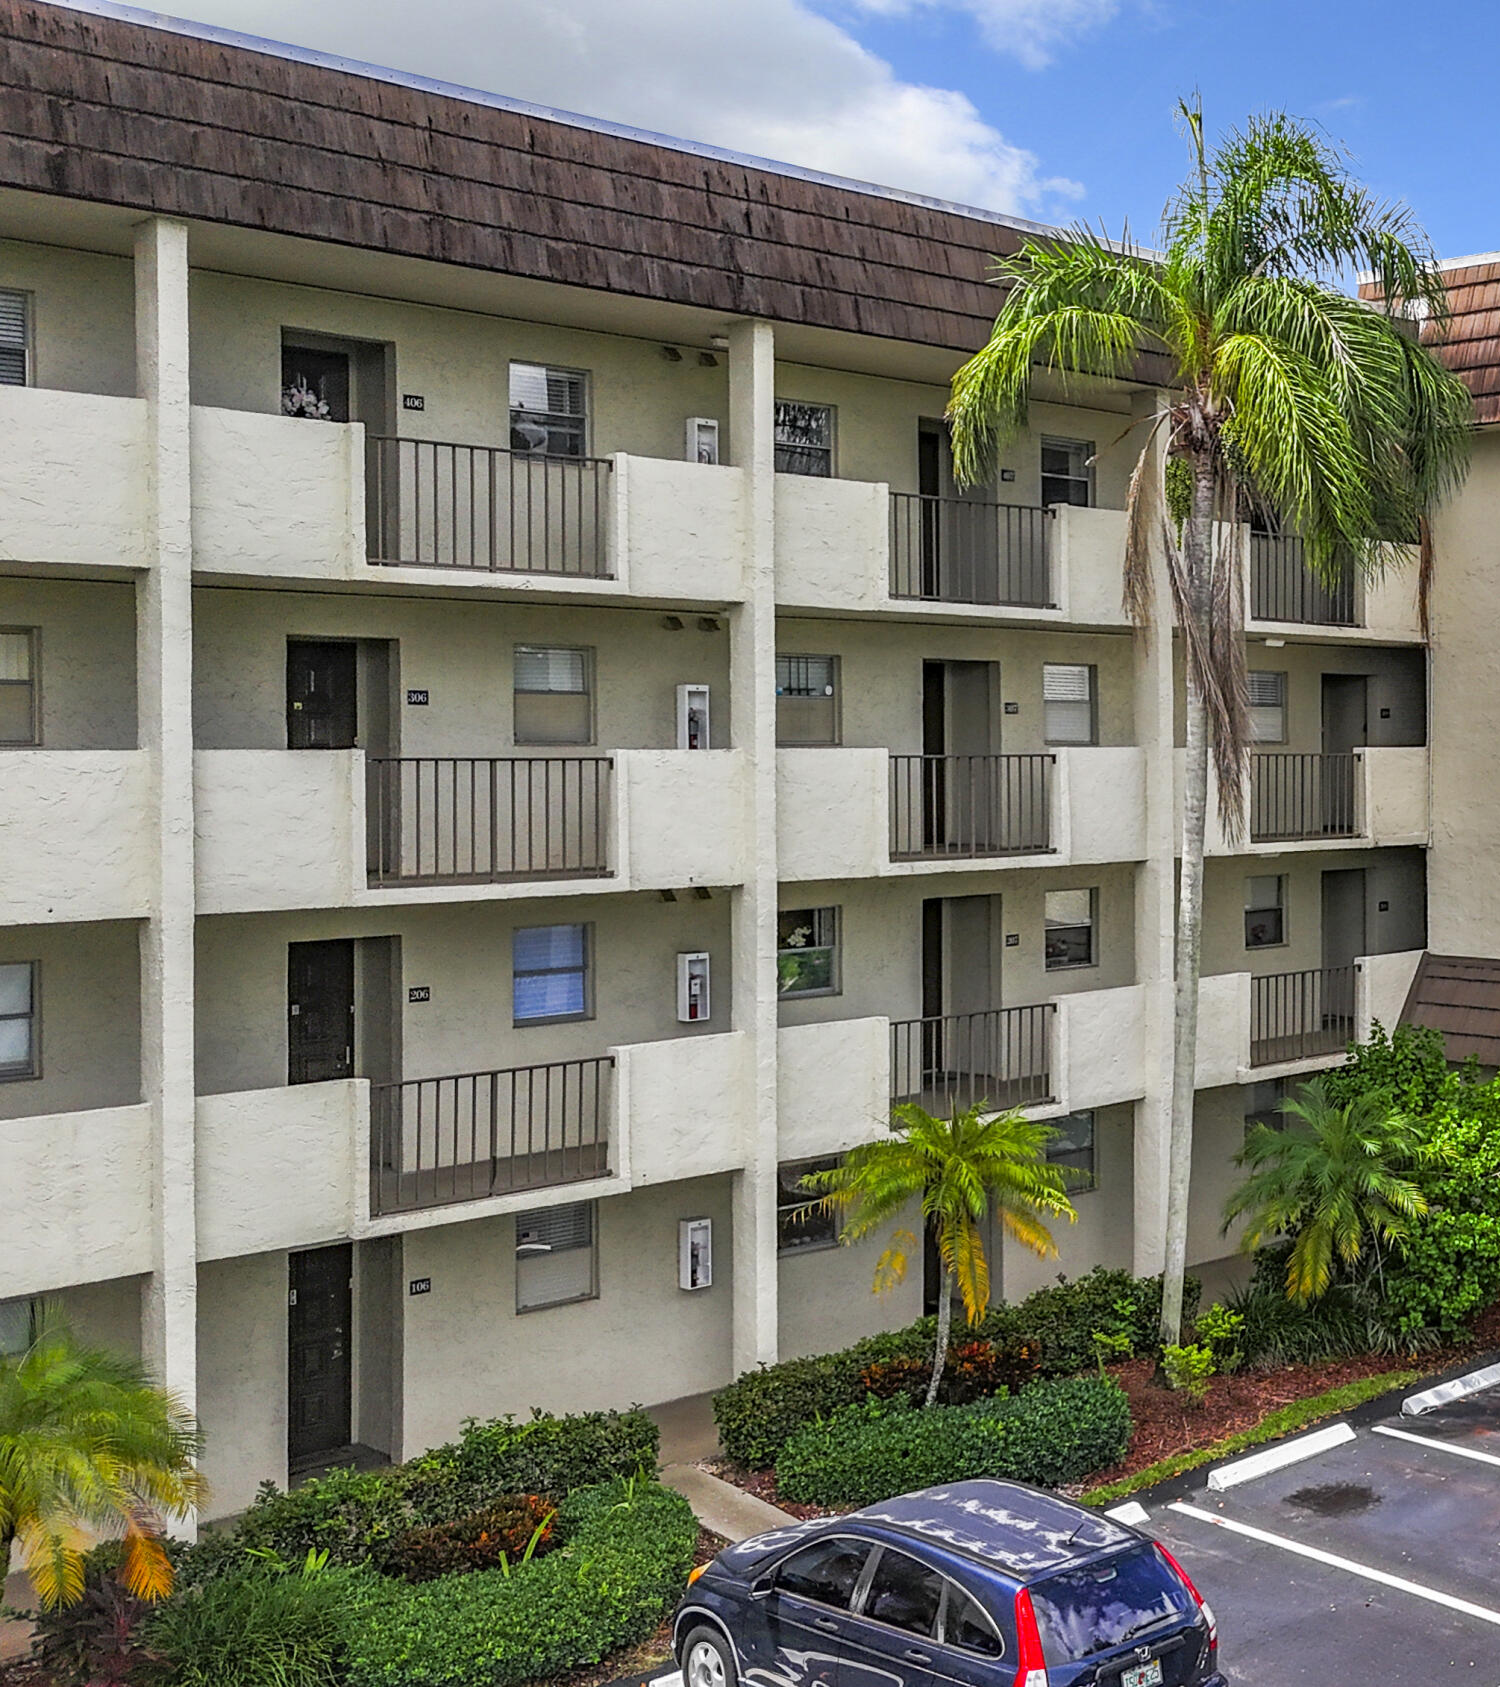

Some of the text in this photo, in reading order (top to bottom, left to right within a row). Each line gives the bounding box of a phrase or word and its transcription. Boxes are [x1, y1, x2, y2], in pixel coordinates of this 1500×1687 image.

[404, 396, 423, 408] 406
[408, 691, 428, 703] 306
[410, 989, 429, 1000] 206
[411, 1280, 430, 1294] 106
